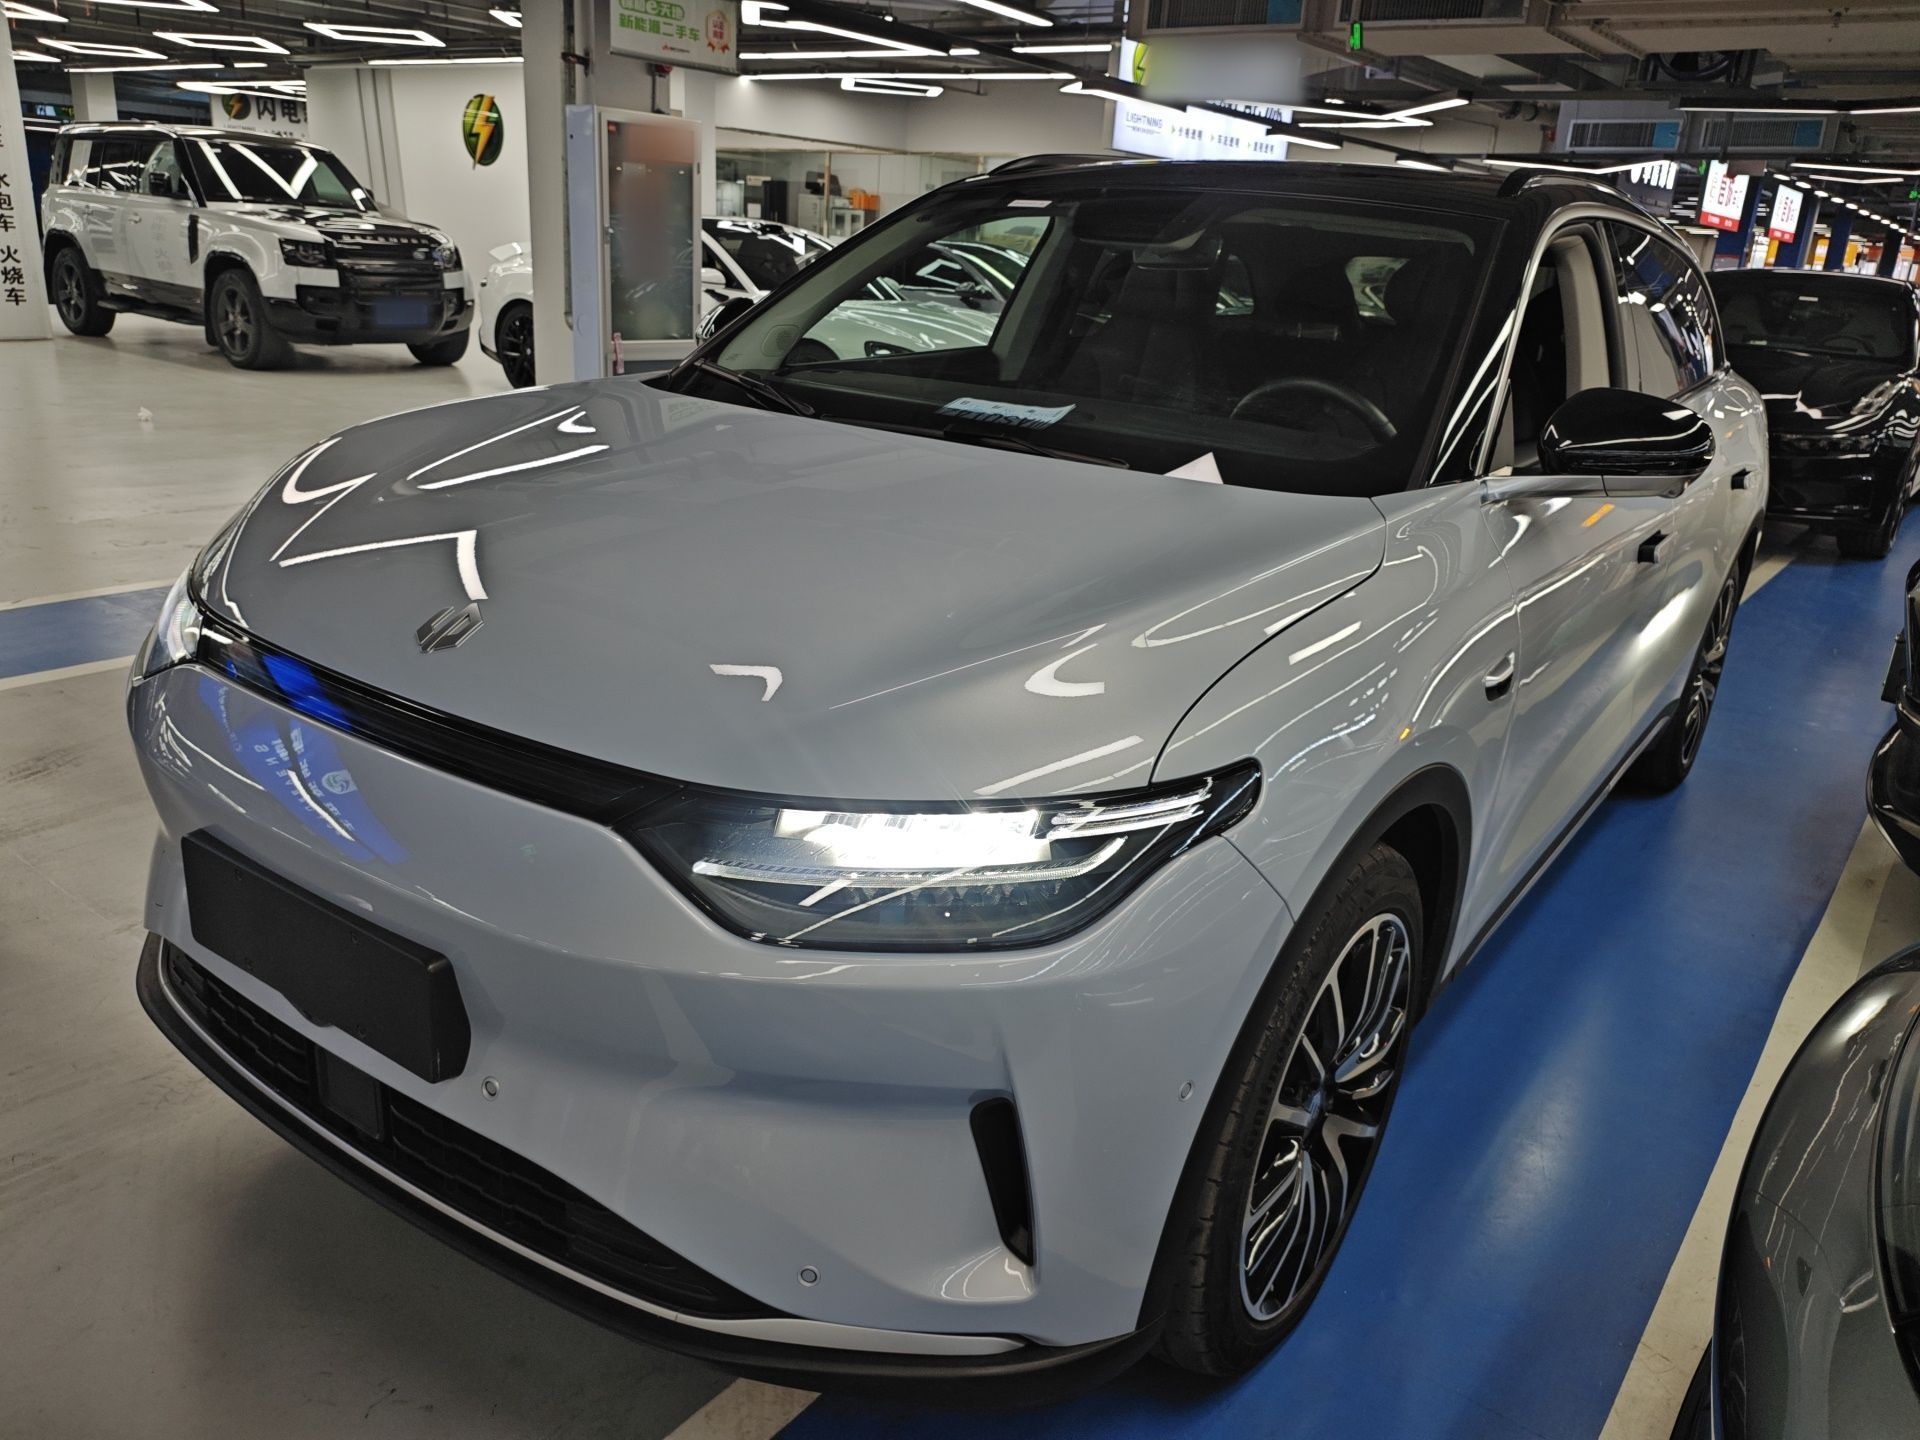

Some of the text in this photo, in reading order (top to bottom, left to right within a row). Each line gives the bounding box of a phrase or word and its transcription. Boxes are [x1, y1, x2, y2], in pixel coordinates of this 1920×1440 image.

[618, 13, 701, 42] 新能源二手车
[254, 96, 308, 124] 闪电
[0, 244, 27, 306] 火烧车
